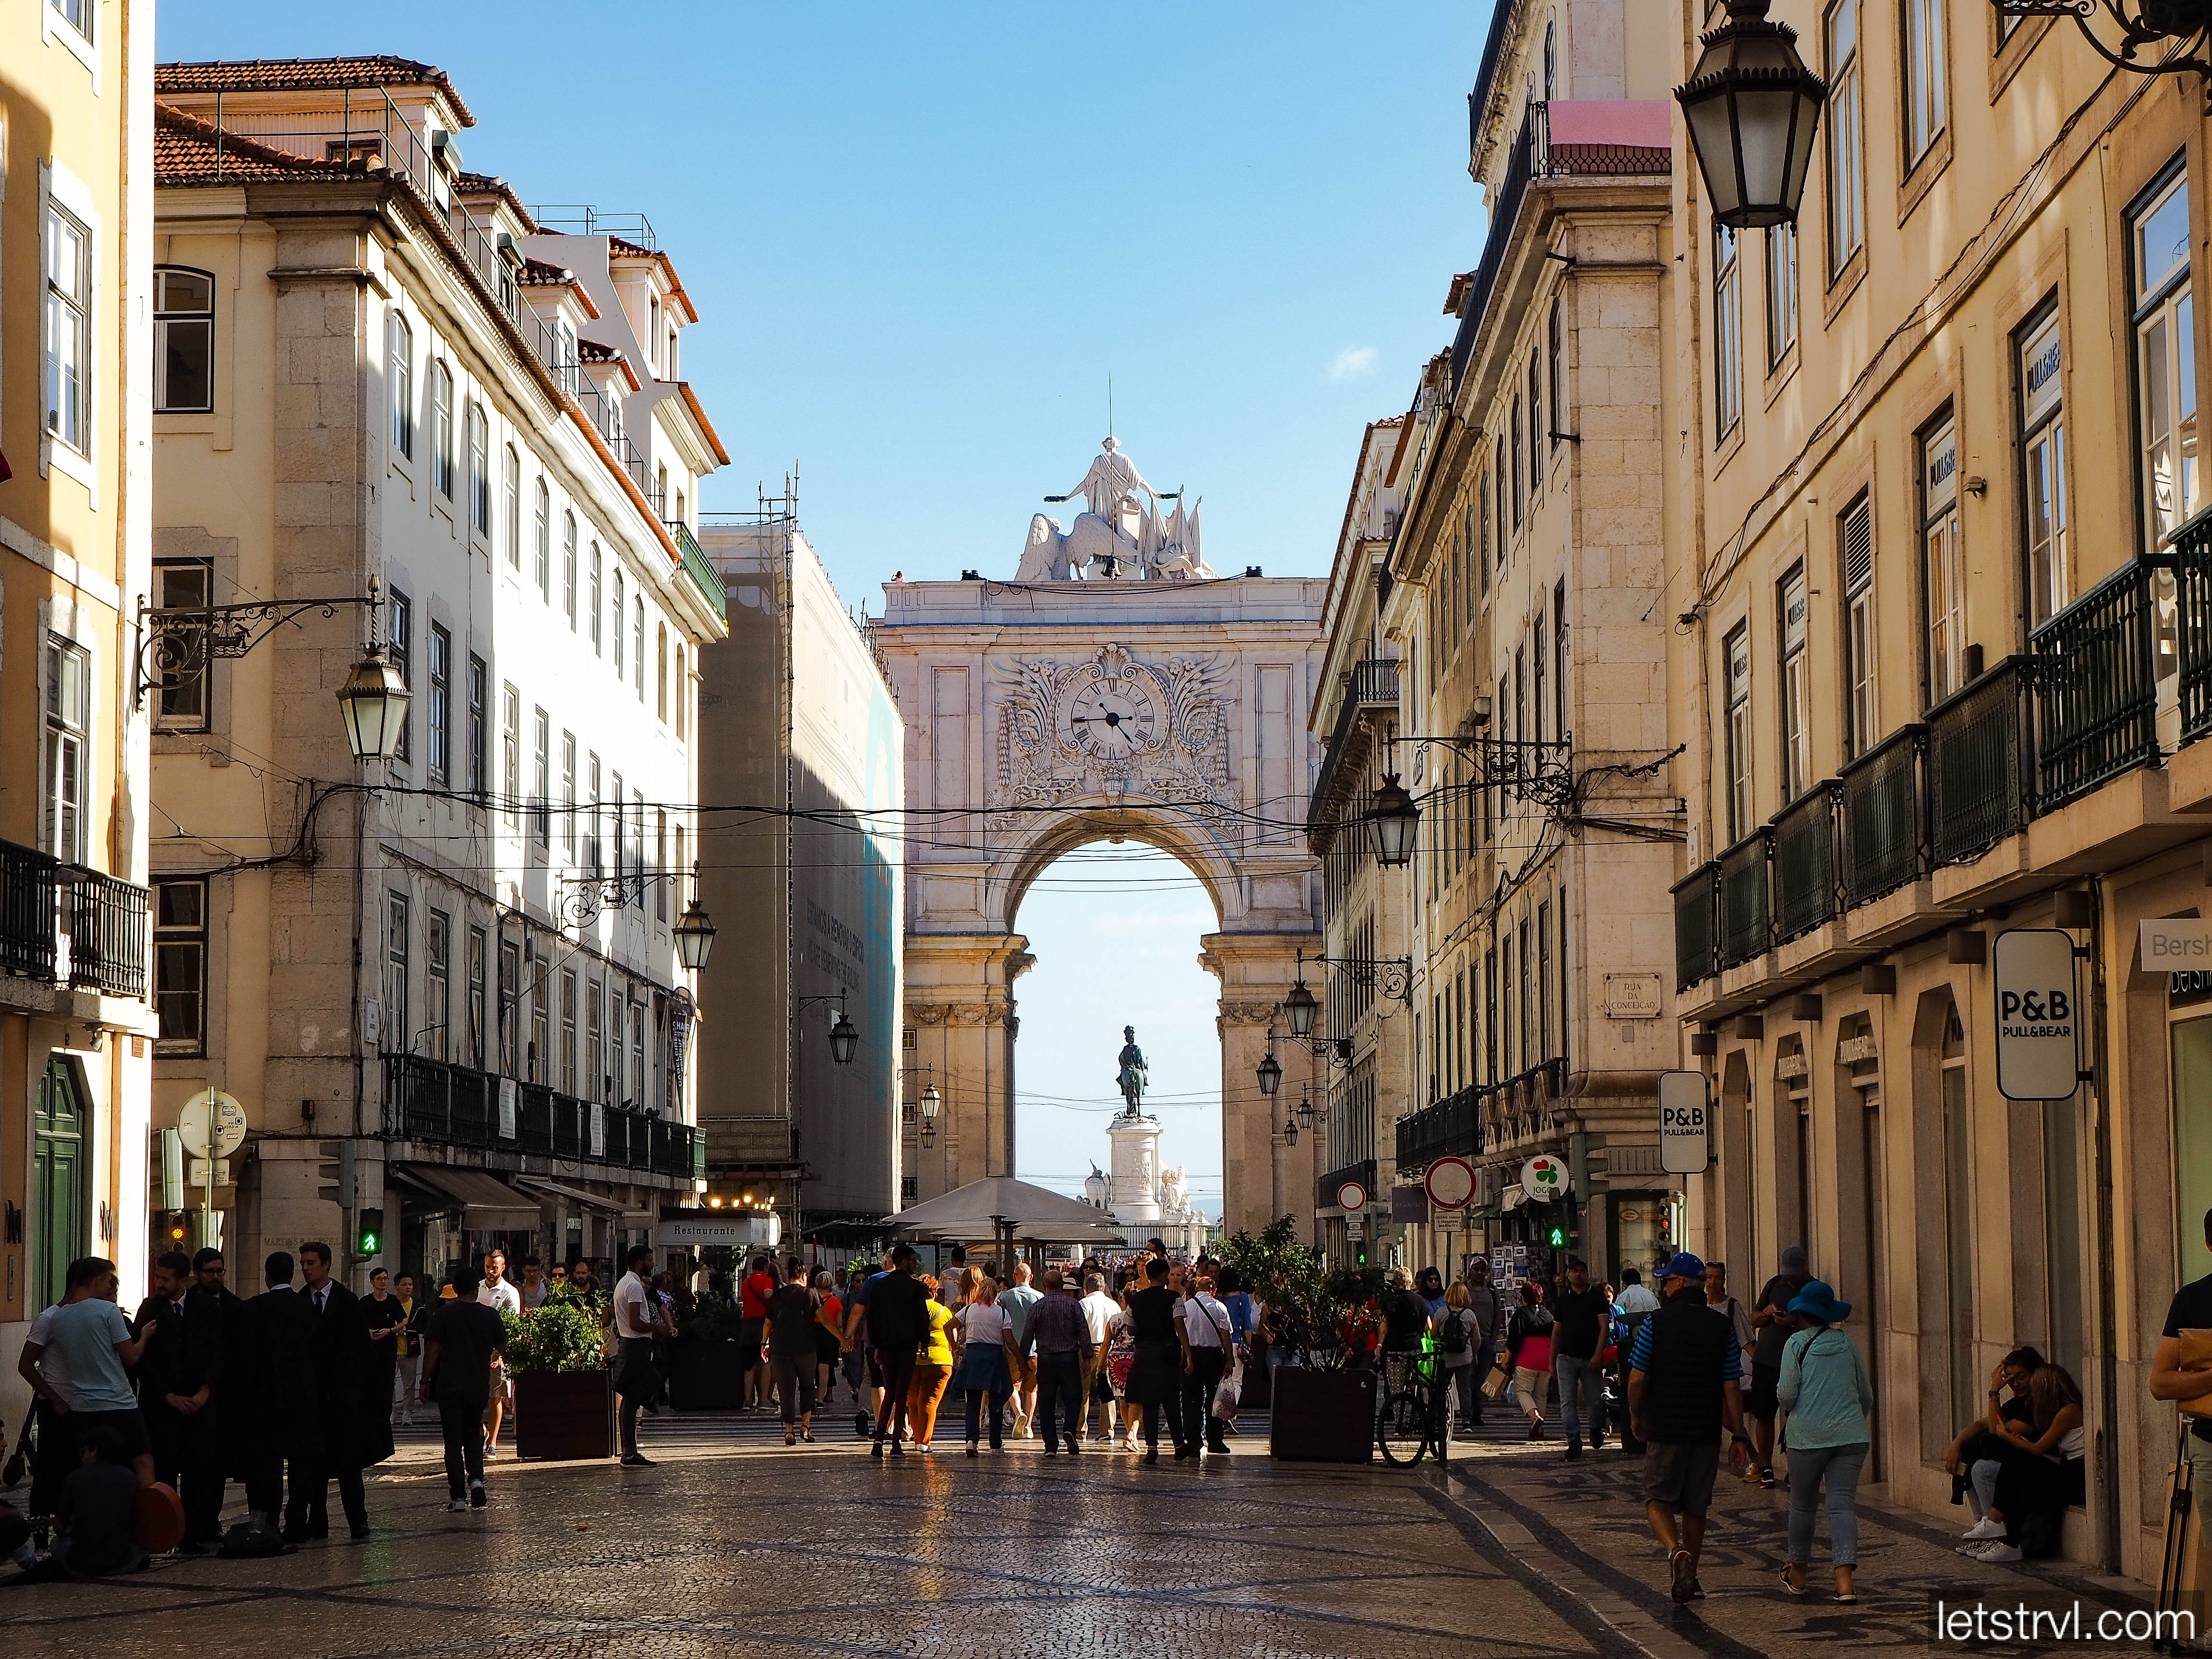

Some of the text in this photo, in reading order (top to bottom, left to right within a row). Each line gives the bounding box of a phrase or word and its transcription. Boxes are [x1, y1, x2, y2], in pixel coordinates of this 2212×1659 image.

[2001, 990, 2069, 1022] P&B
[2002, 1026, 2071, 1037] PULL&BEAR
[1663, 1107, 1704, 1126] P&B
[673, 1225, 735, 1235] Restaurante
